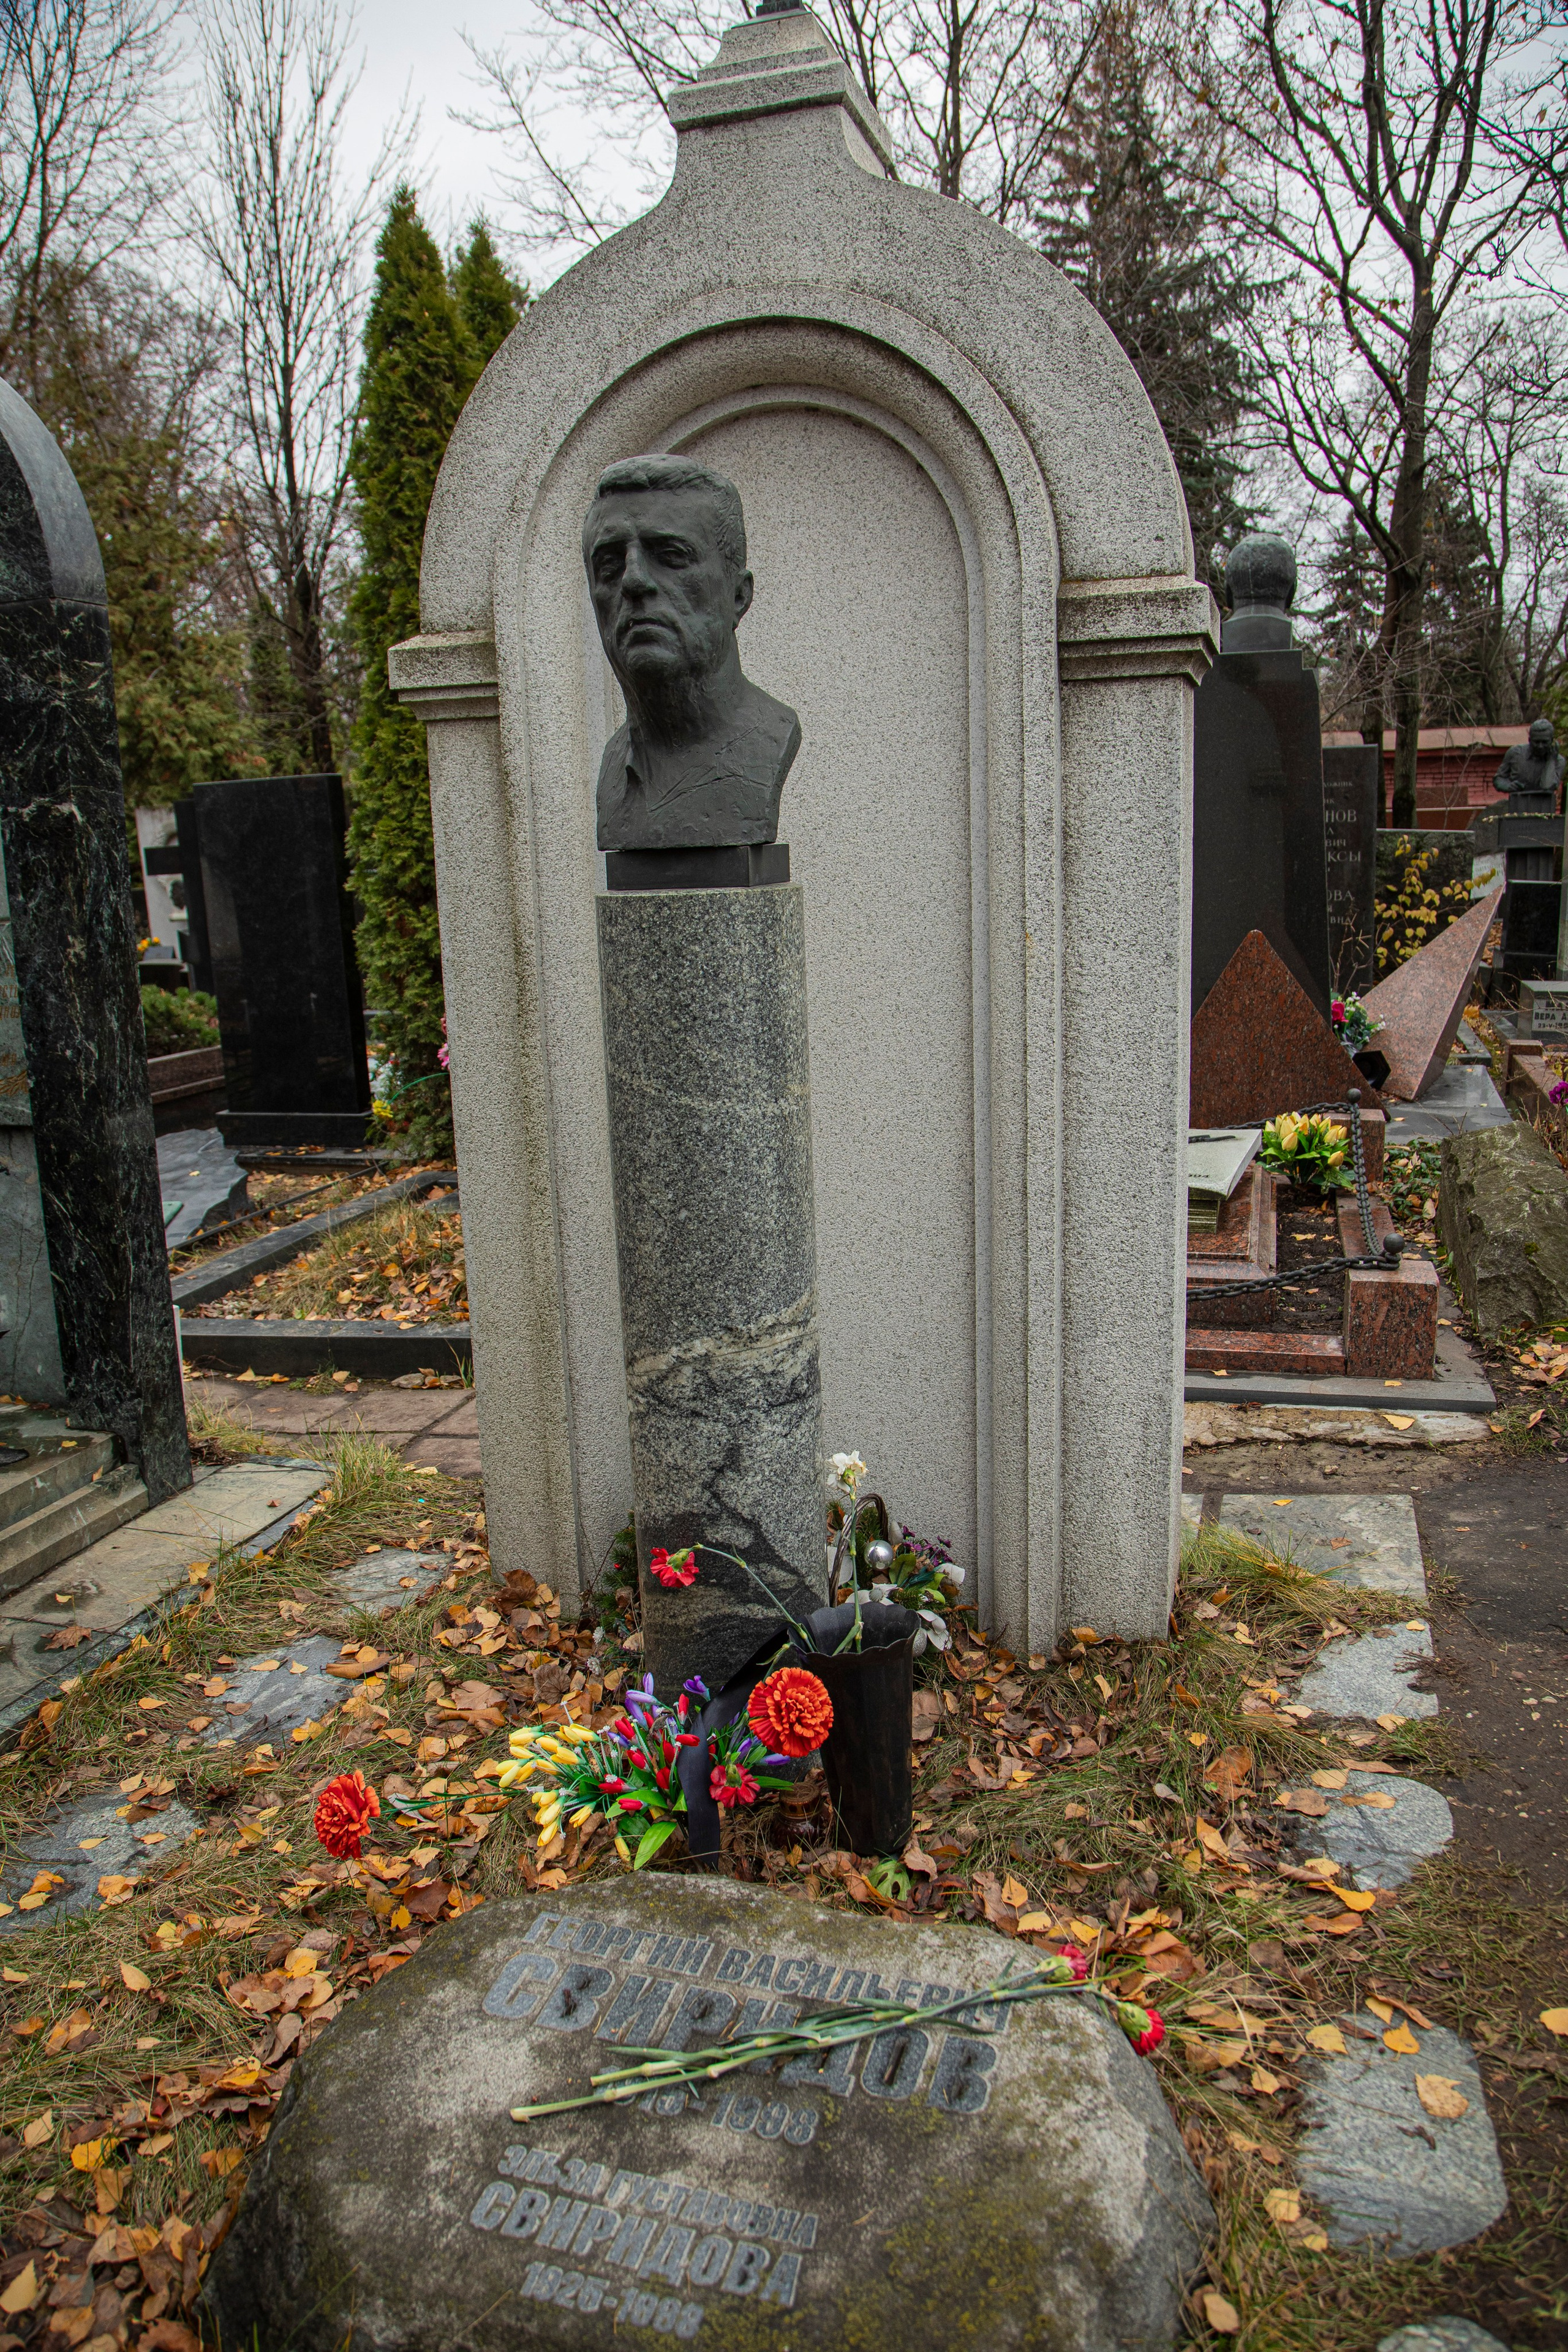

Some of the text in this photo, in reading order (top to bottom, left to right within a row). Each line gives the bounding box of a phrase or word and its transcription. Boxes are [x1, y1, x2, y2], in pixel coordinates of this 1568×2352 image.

[1325, 809, 1357, 823] НОВ
[1328, 851, 1360, 862] КСЫ
[1534, 1011, 1556, 1020] ВЕРА
[522, 1911, 715, 1977] ГЕОРГИЙ
[482, 1953, 999, 2113] СВИРИДОВ
[498, 2144, 819, 2249] ЭЛЬЗА ГУСТАВОВНА
[470, 2180, 804, 2309] СВИРИДОВА
